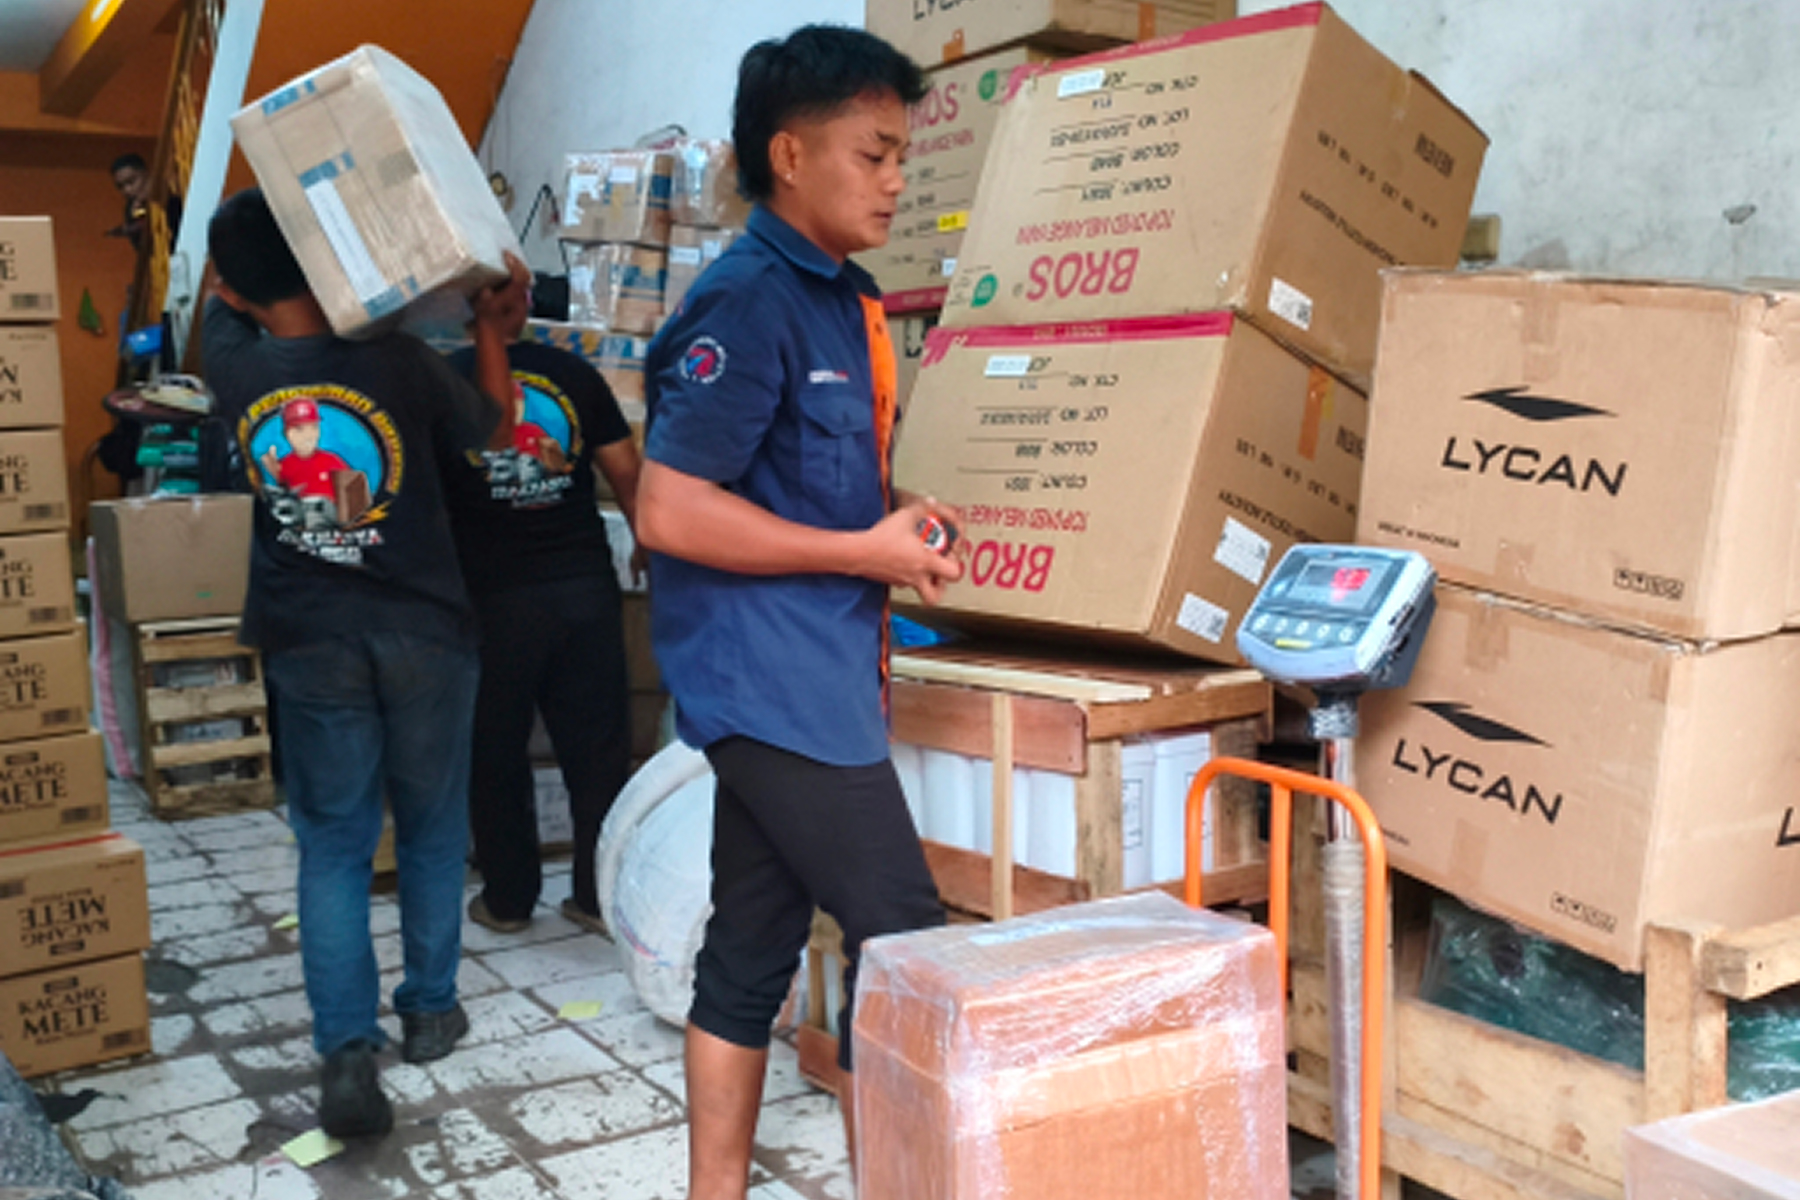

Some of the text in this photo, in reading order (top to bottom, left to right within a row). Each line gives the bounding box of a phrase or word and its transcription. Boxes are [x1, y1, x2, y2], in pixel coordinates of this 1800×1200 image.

[1028, 248, 1139, 301] BROS
[1441, 436, 1627, 497] LYCAN
[961, 541, 1056, 593] BRO
[1392, 738, 1562, 824] LYCAN
[18, 893, 107, 930] METE
[20, 917, 110, 950] KACANG
[18, 984, 107, 1017] KACANG
[21, 1001, 109, 1041] METE
